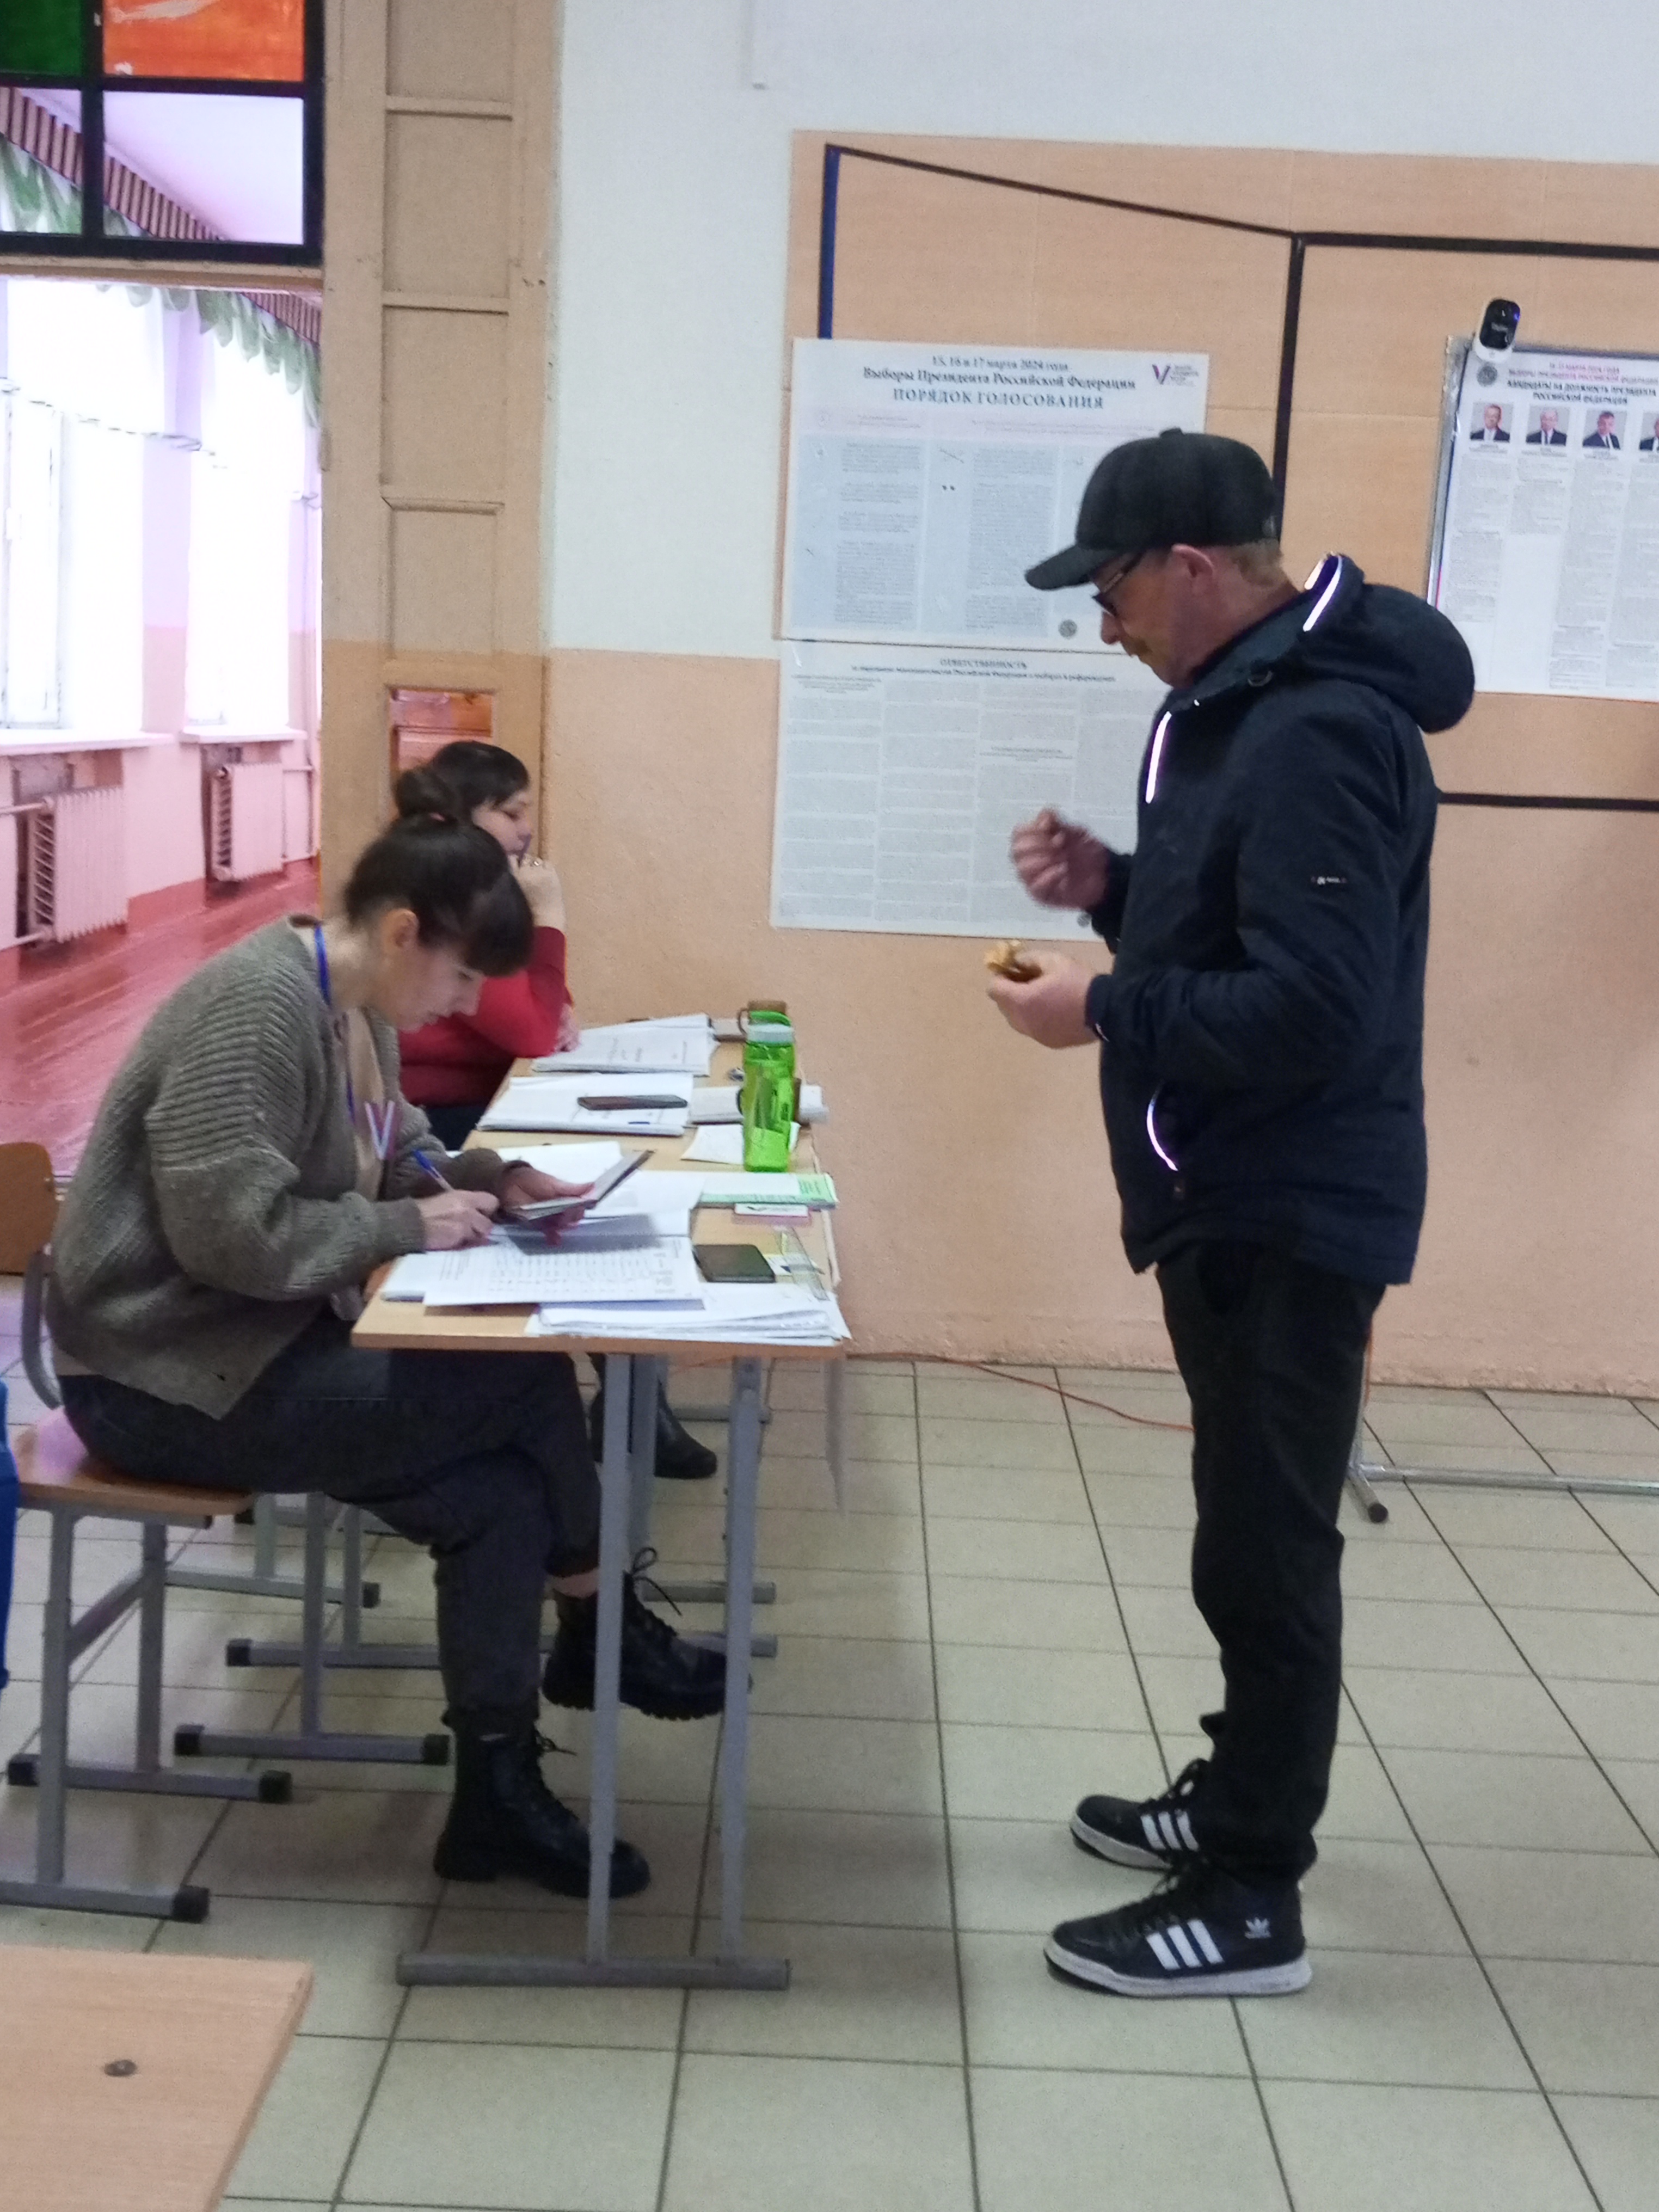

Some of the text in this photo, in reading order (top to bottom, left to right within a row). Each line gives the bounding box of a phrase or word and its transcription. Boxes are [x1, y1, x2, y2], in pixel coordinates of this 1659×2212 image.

[864, 366, 1136, 391] Выборы Президента Российской Федерации
[893, 388, 1104, 409] ПОРЯДОК ГОЛОСОВАНИЯ
